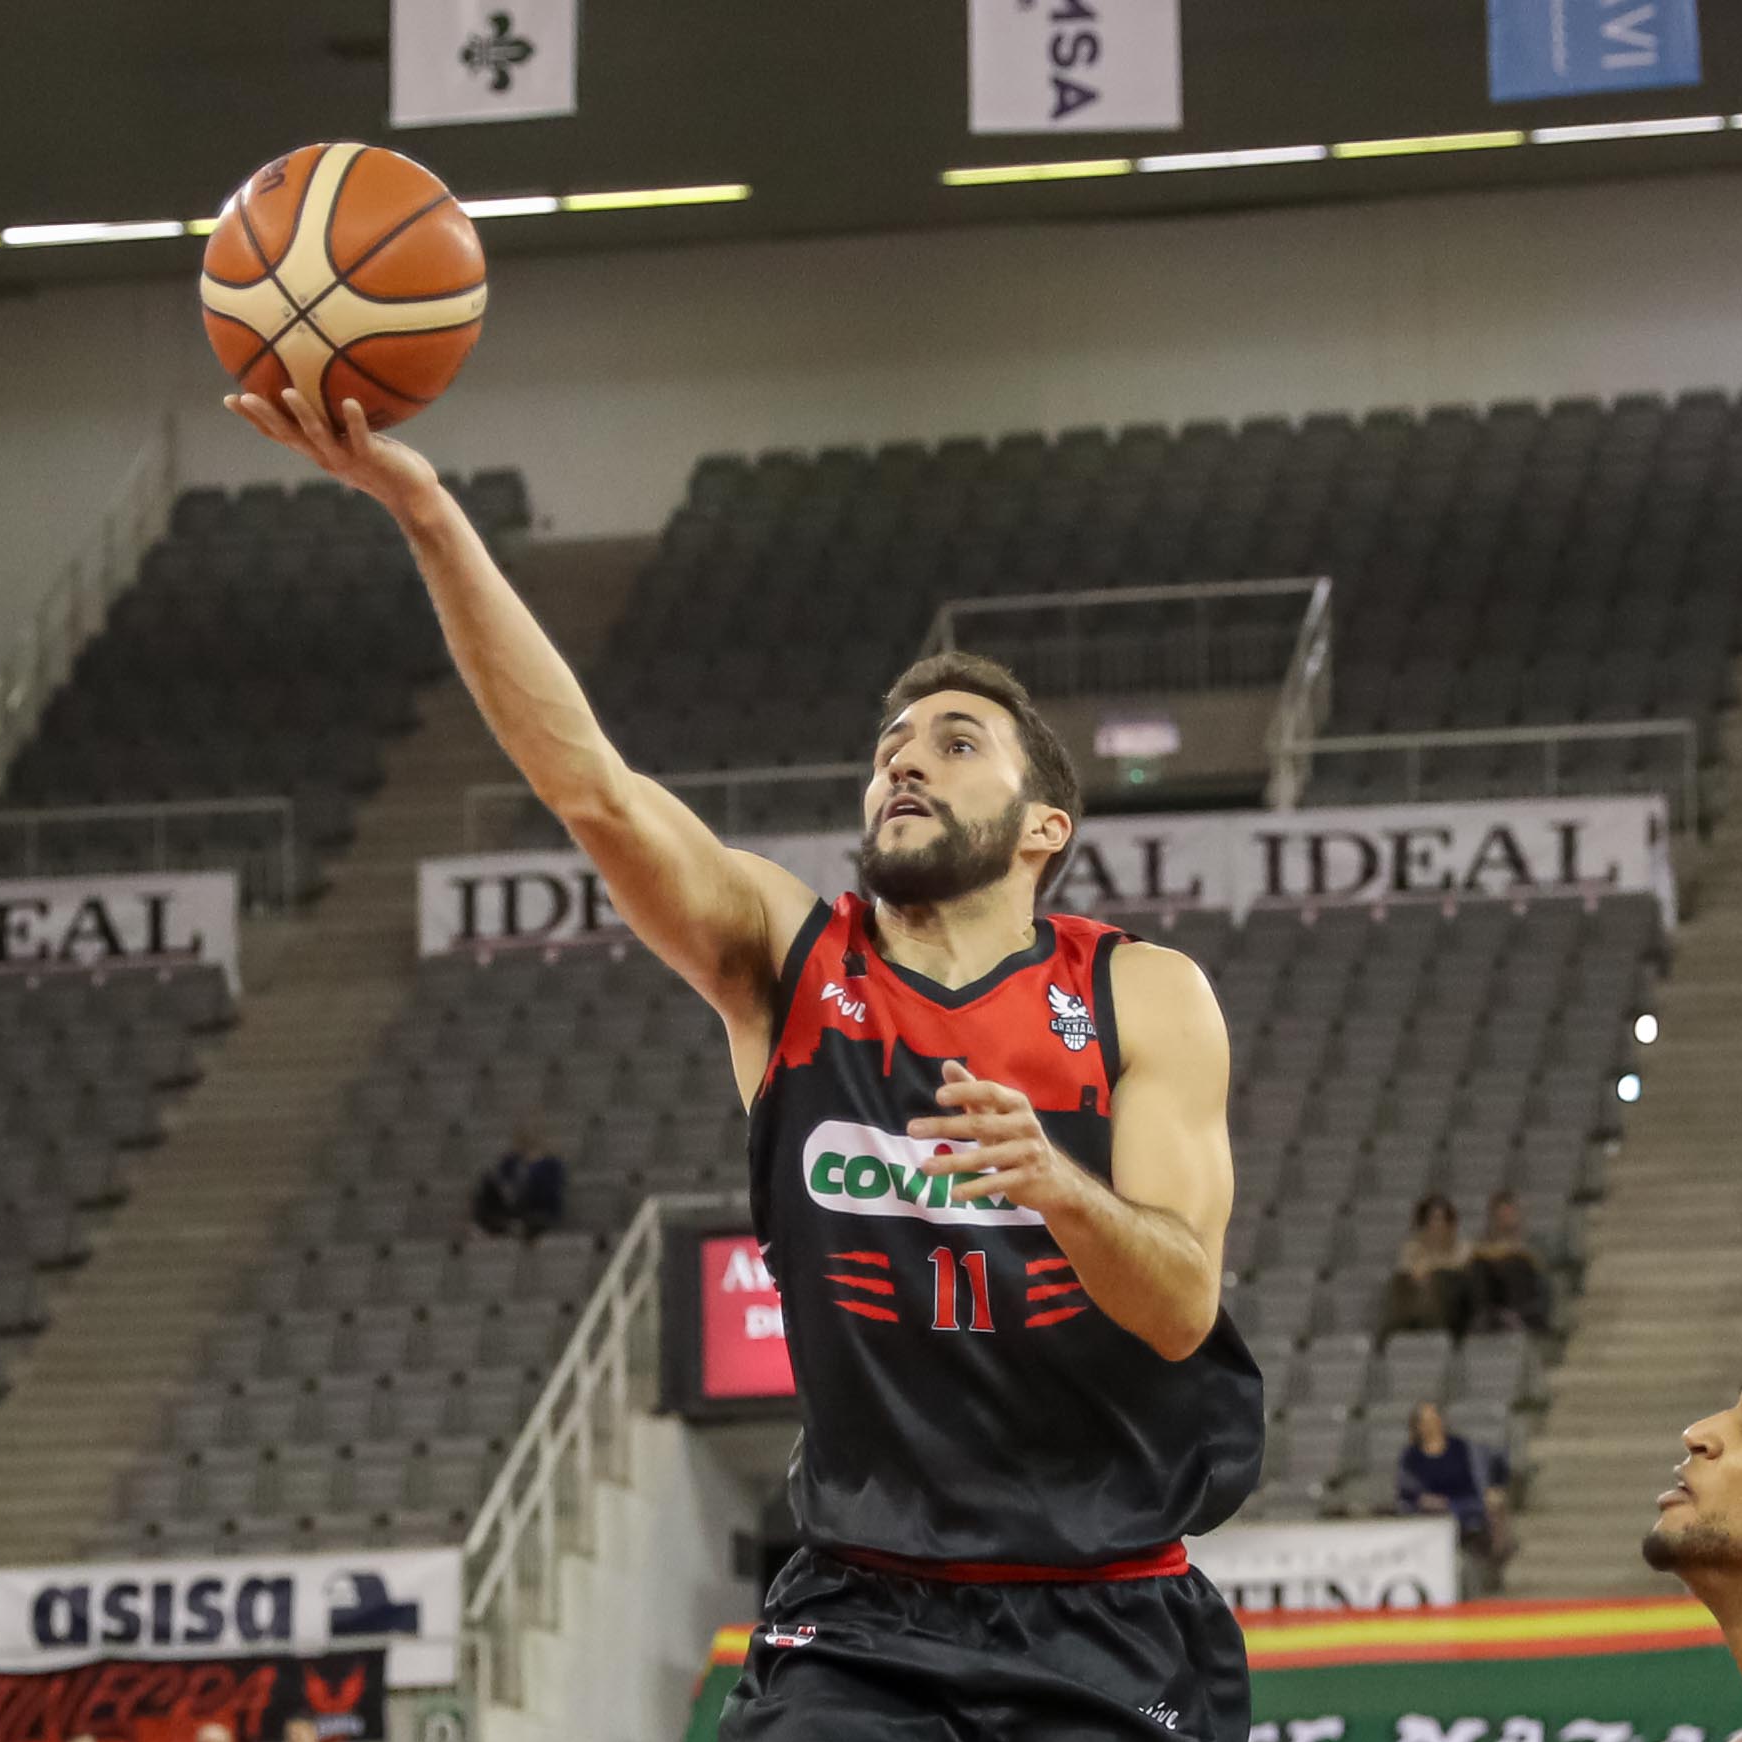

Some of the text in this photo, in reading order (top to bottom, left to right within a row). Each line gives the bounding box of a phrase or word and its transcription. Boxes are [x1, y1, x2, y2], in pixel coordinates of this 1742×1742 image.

[1260, 822, 1619, 899] IDEAL
[810, 1150, 1019, 1211] COVI
[928, 1246, 996, 1333] 11
[31, 1571, 294, 1650] asisa
